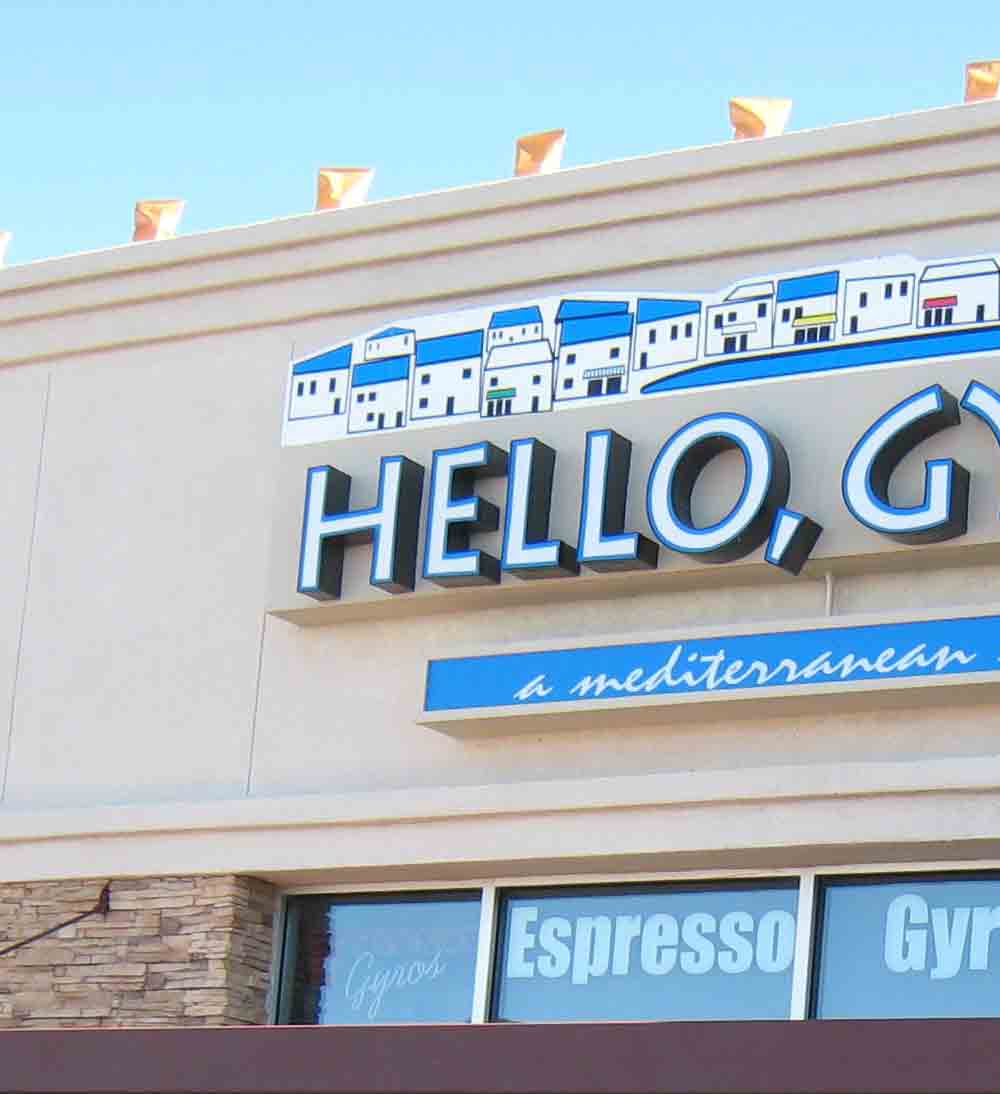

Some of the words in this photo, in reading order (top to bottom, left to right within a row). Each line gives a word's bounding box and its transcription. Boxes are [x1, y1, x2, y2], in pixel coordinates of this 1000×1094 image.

[297, 411, 814, 598] HELLO,
[513, 669, 553, 700] a
[571, 643, 976, 697] mediterranean
[345, 945, 450, 1021] Gyros
[507, 906, 797, 984] Espresso
